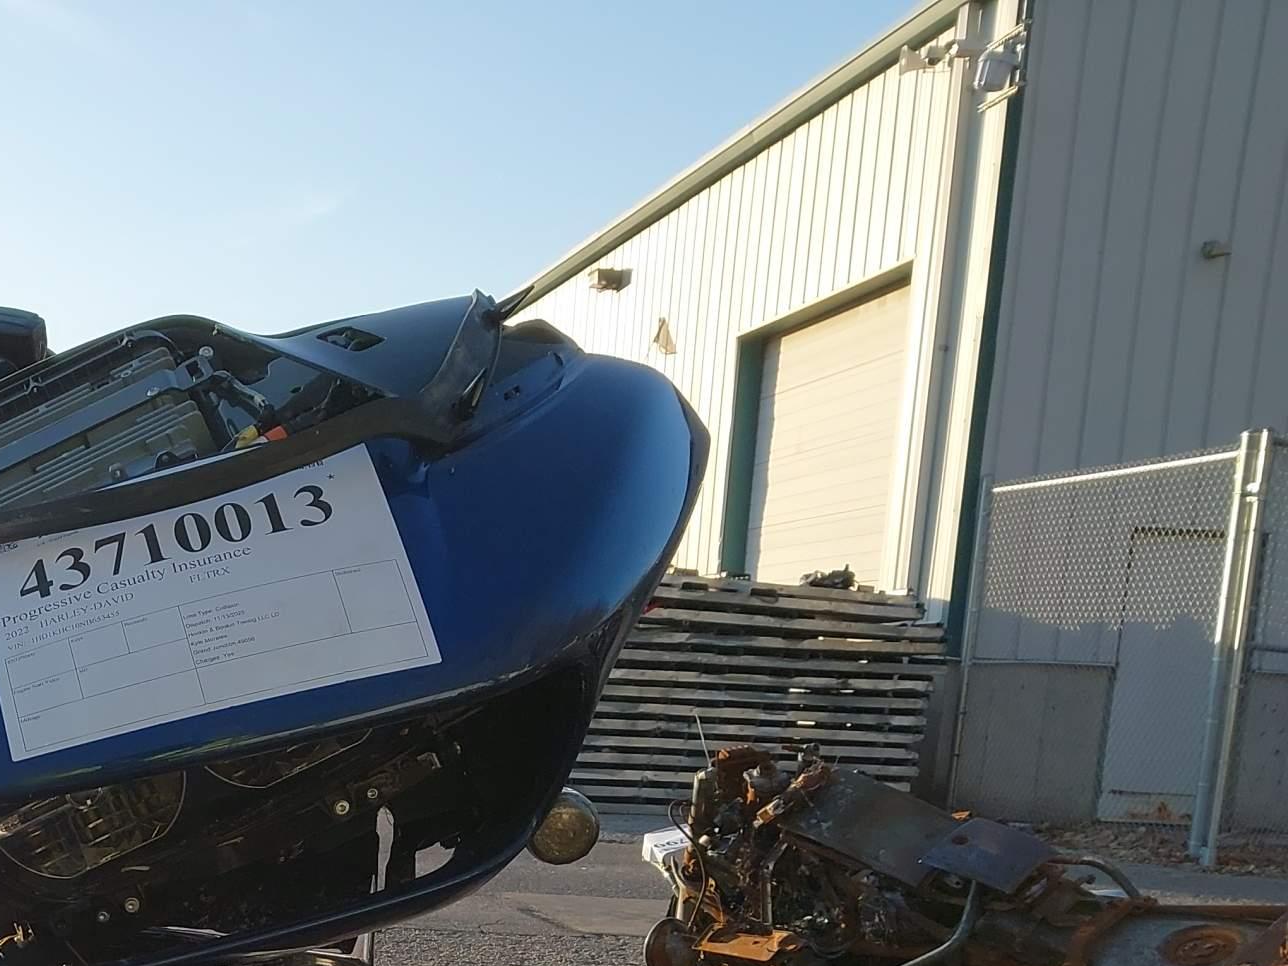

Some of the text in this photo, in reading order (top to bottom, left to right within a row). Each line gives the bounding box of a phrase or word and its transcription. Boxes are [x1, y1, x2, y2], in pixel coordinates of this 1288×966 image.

[19, 485, 333, 599] 43710013
[0, 546, 252, 628] Progressive Casualty Insurance
[39, 592, 134, 629] HARLEY-DAVID
